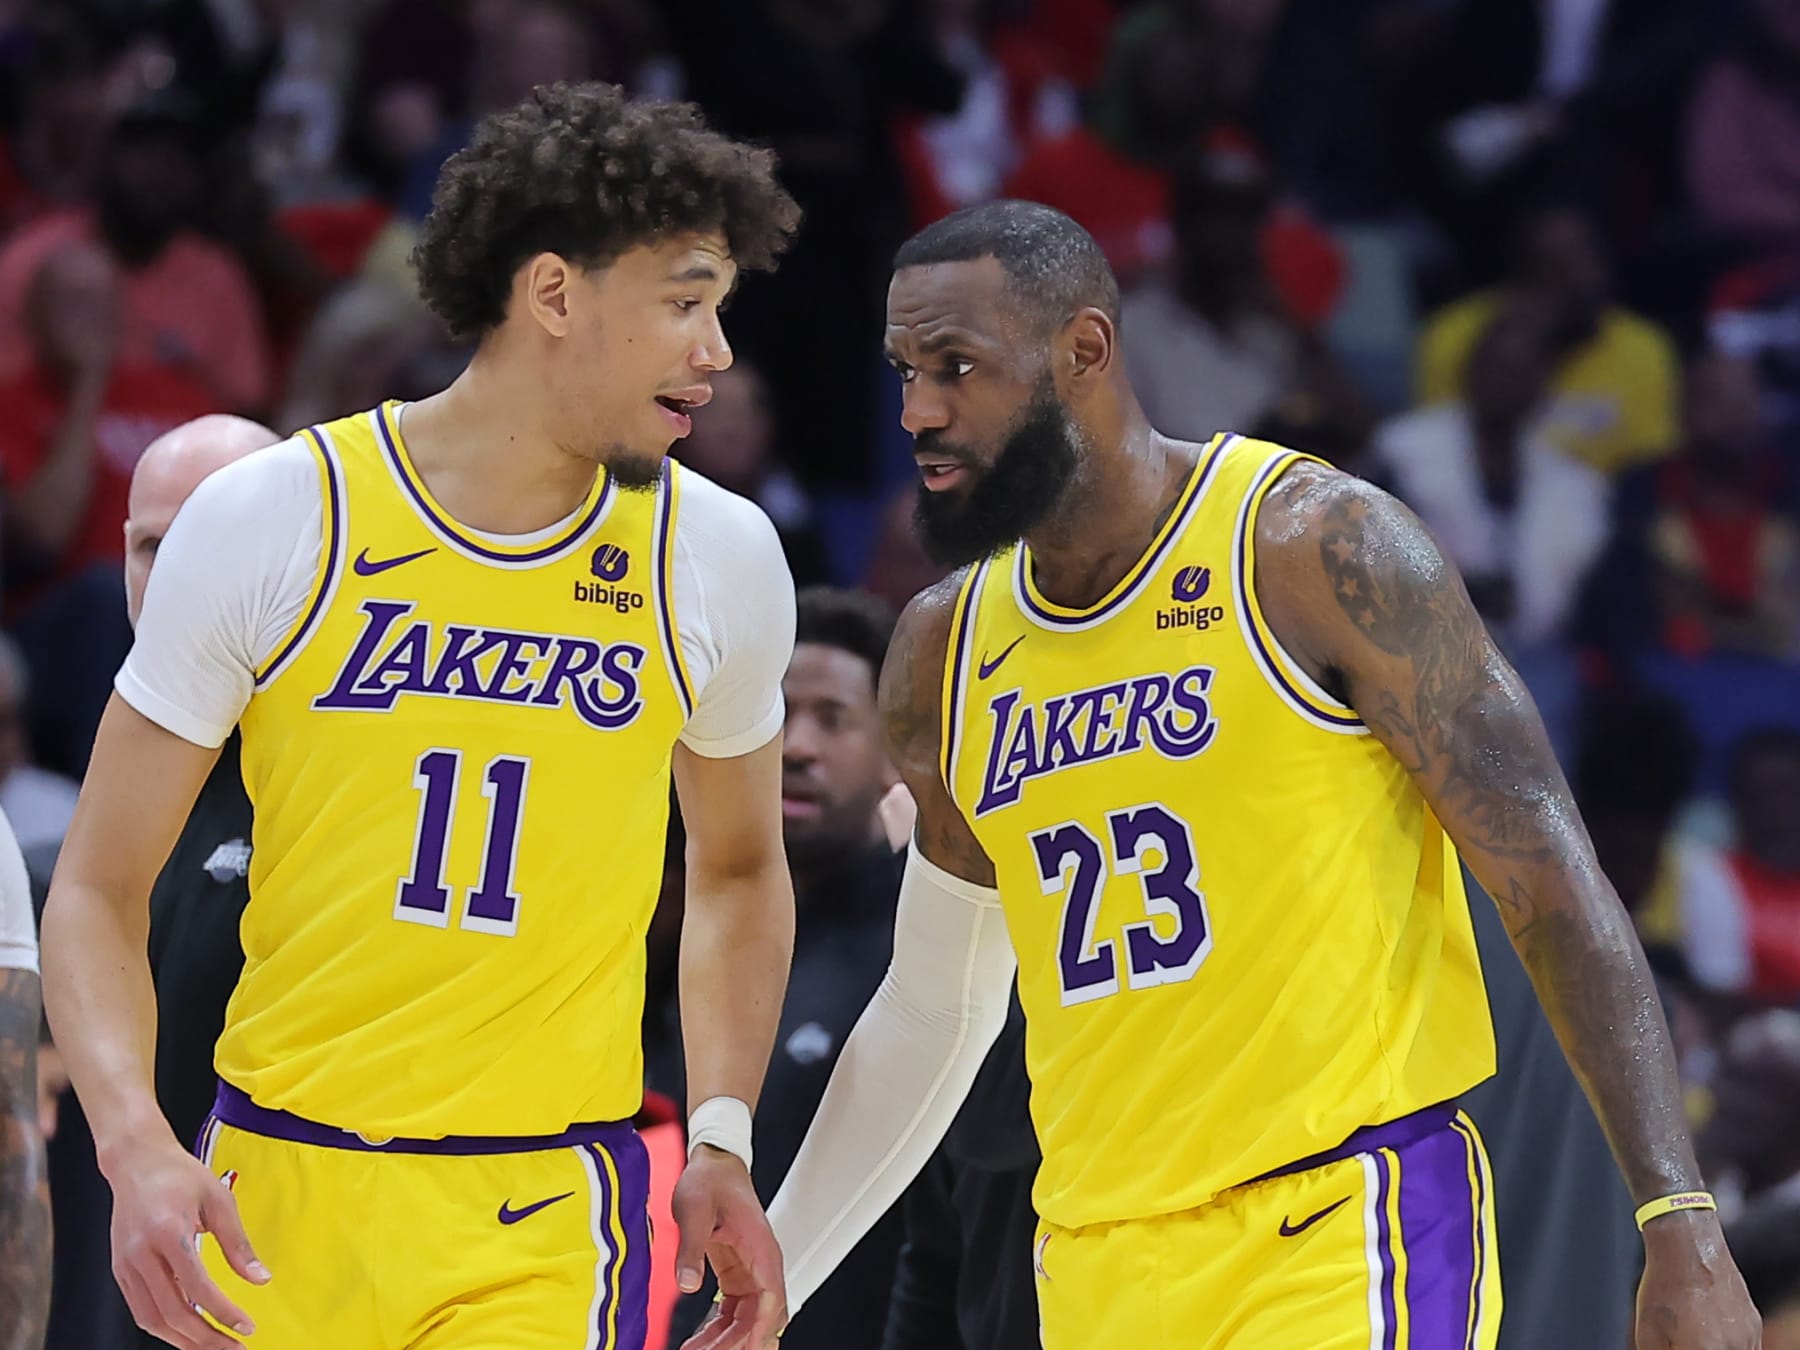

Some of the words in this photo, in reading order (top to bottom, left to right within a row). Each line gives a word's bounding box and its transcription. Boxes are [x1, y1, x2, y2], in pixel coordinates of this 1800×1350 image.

[310, 599, 649, 731] LAKERS
[574, 581, 643, 614] bibigo
[1156, 605, 1224, 631] bibigo
[975, 664, 1219, 820] LAKERS
[393, 746, 531, 937] 11
[1028, 801, 1213, 1007] 23
